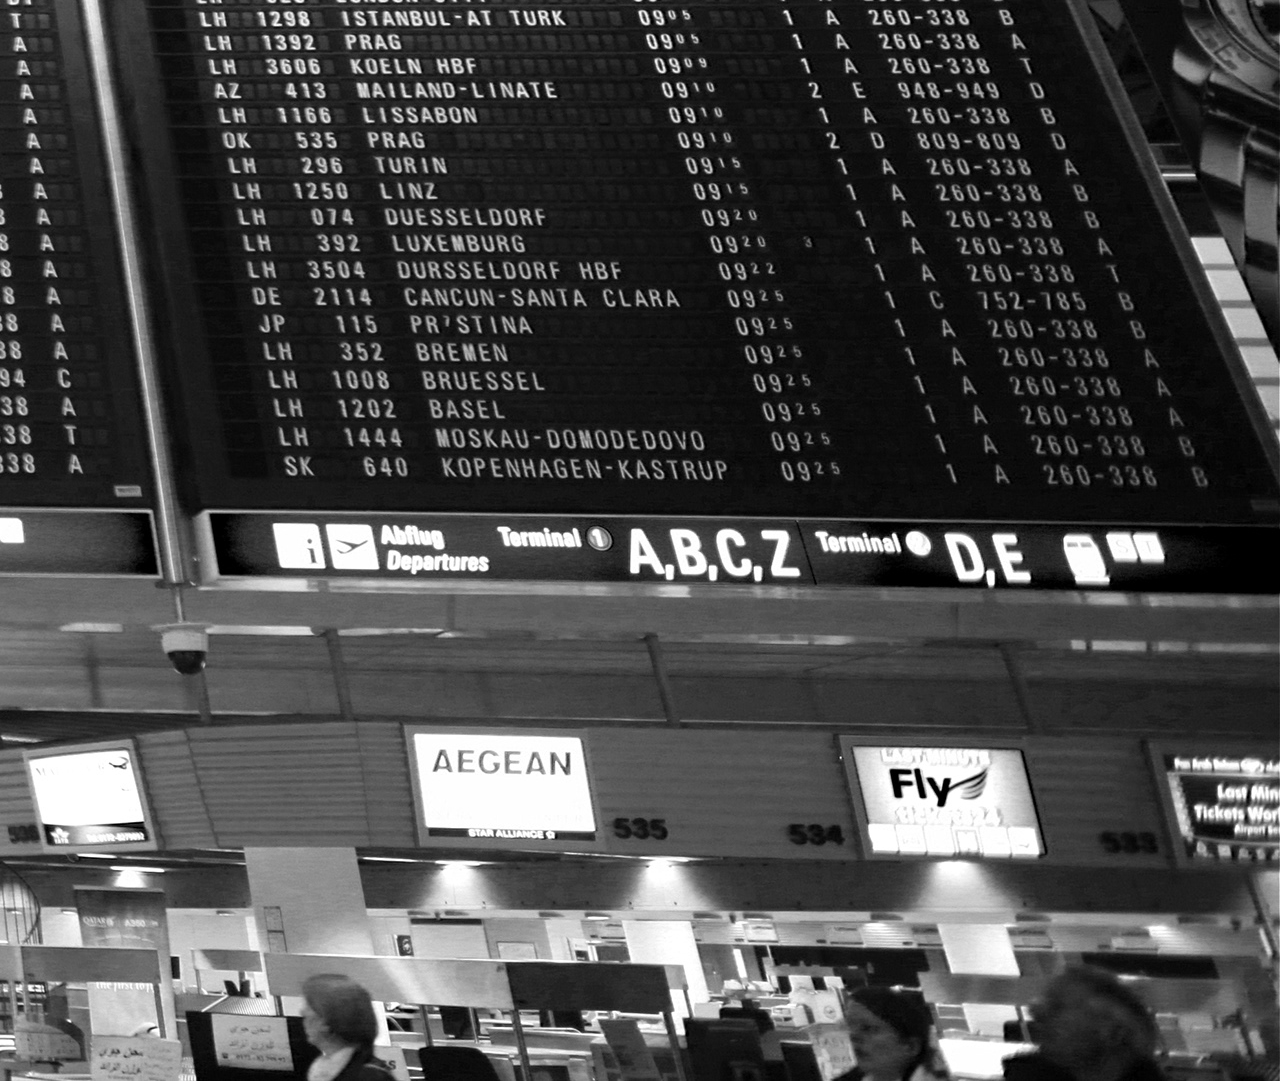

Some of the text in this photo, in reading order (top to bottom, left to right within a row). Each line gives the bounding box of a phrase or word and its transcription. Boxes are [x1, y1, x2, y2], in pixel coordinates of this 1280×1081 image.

[342, 10, 566, 26] ISTANBUL-AT TURK
[286, 82, 999, 99] 413 MAILAND-LINATE 948-949
[296, 132, 1020, 150] 535 PRAG 809-809
[392, 235, 525, 252] LUXEMBURG
[397, 261, 621, 280] DURSSELDORF HBF
[404, 288, 1086, 310] CANCUN-SANTA CLARA 752-785
[435, 428, 704, 450] MOSKAU-DOMODEDOVO
[363, 457, 1157, 486] 640 KOPENHAGEN-KASTRUP 260-338
[381, 525, 1031, 588] Abflug Terminal A,B,C,Z Terminal D,E
[387, 549, 489, 574] Departures
[432, 749, 572, 776] AEGEAN
[889, 767, 952, 808] Fly
[1217, 784, 1247, 800] Last
[1194, 804, 1245, 821] Tickets
[468, 827, 544, 840] STAR ALLIANCE
[613, 817, 668, 840] 535
[788, 823, 844, 846] 534
